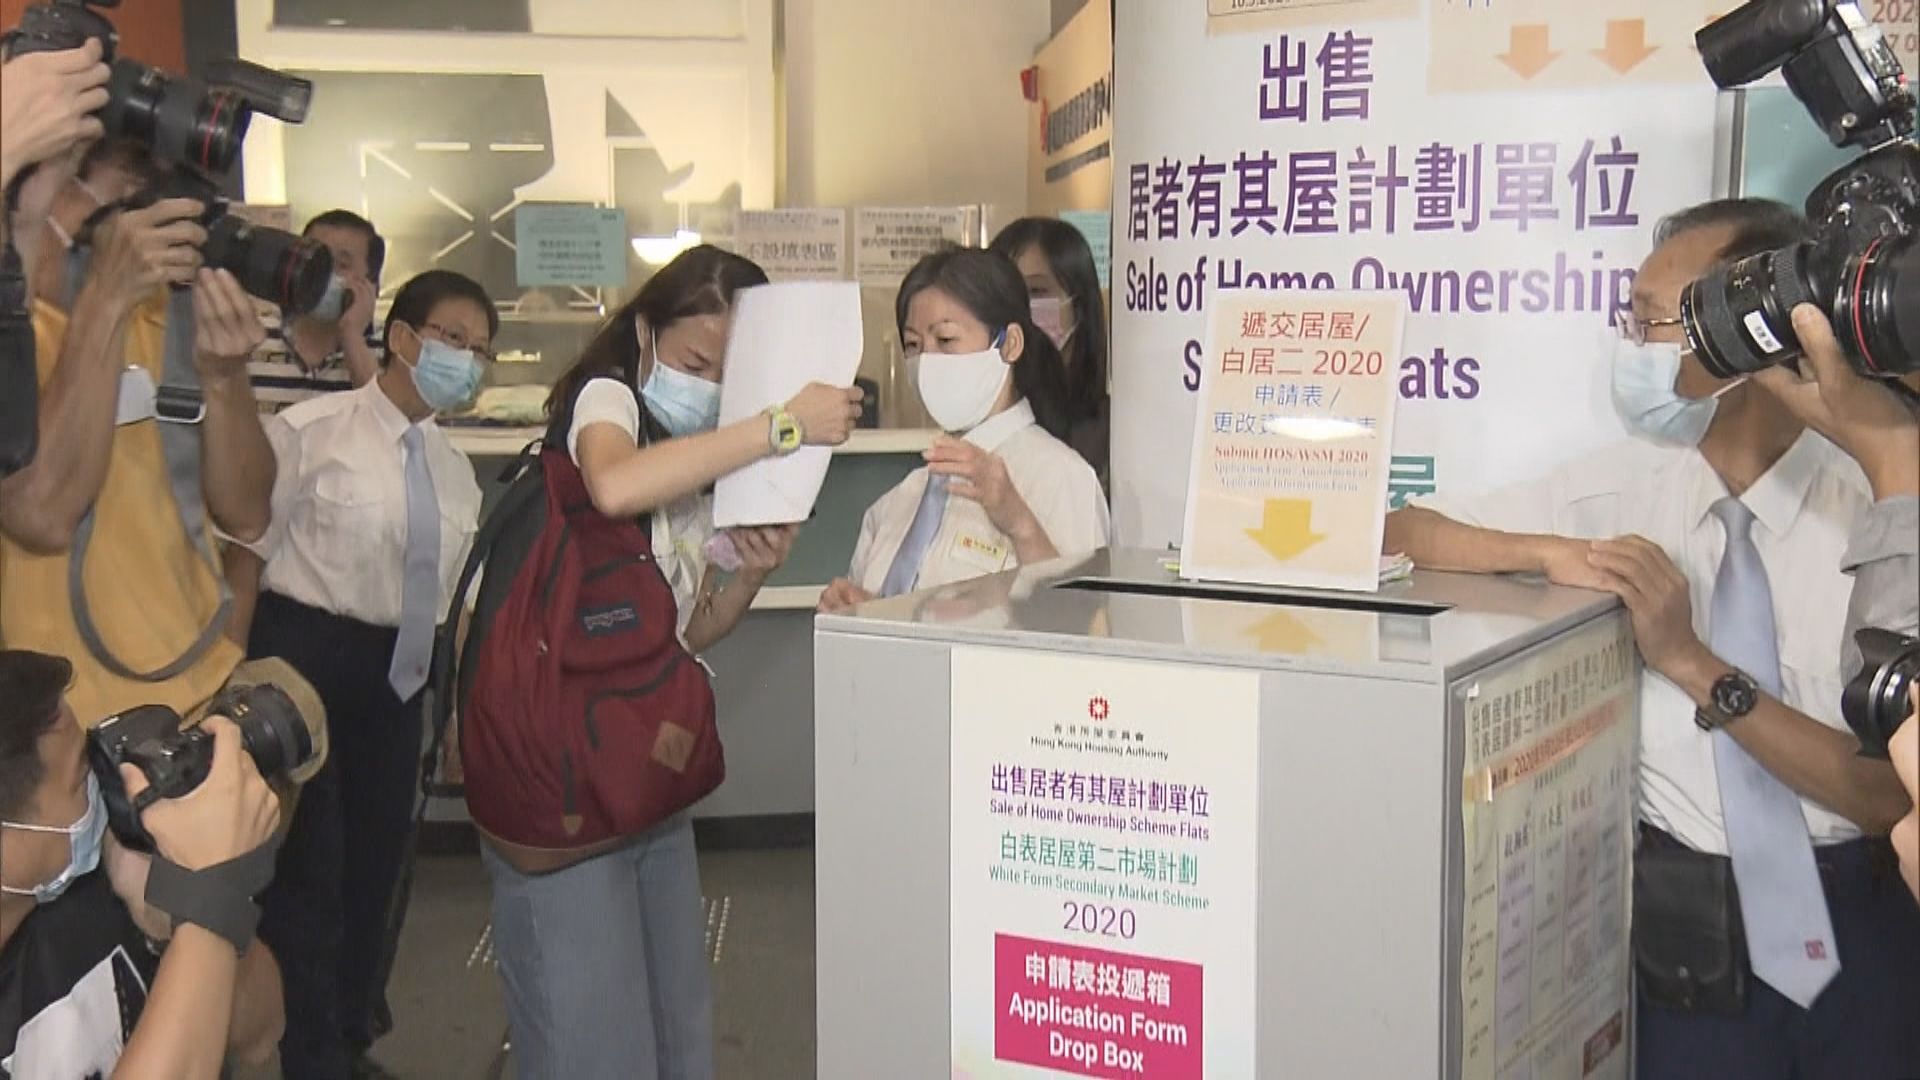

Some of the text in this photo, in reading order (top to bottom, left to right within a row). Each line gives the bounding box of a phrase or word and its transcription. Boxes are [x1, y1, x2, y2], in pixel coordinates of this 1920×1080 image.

[1260, 30, 1373, 122] 出售
[1128, 136, 1639, 240] 居者有其屋計劃單位
[1126, 258, 1168, 312] Sale
[1176, 254, 1207, 312] of
[1222, 347, 1304, 375] 白居二
[1313, 350, 1383, 376] 2020
[1255, 384, 1323, 408] 申請表
[1338, 450, 1369, 463] 2020
[1031, 735, 1168, 761] Hong Kong Housing Authority
[991, 762, 1209, 818] 出售居者有其屋計劃單位
[990, 799, 1209, 840] Sale of Home Ownership Scheme Flats
[1001, 831, 1198, 886] 白表居屋第二市場計劃
[989, 864, 1209, 910] White Form Secondary Market Scheme
[1063, 900, 1136, 940] 2020
[1025, 951, 1171, 1008] 申請表投遞箱
[1009, 991, 1188, 1046] Application Form
[1049, 1031, 1144, 1073] Drop Box
